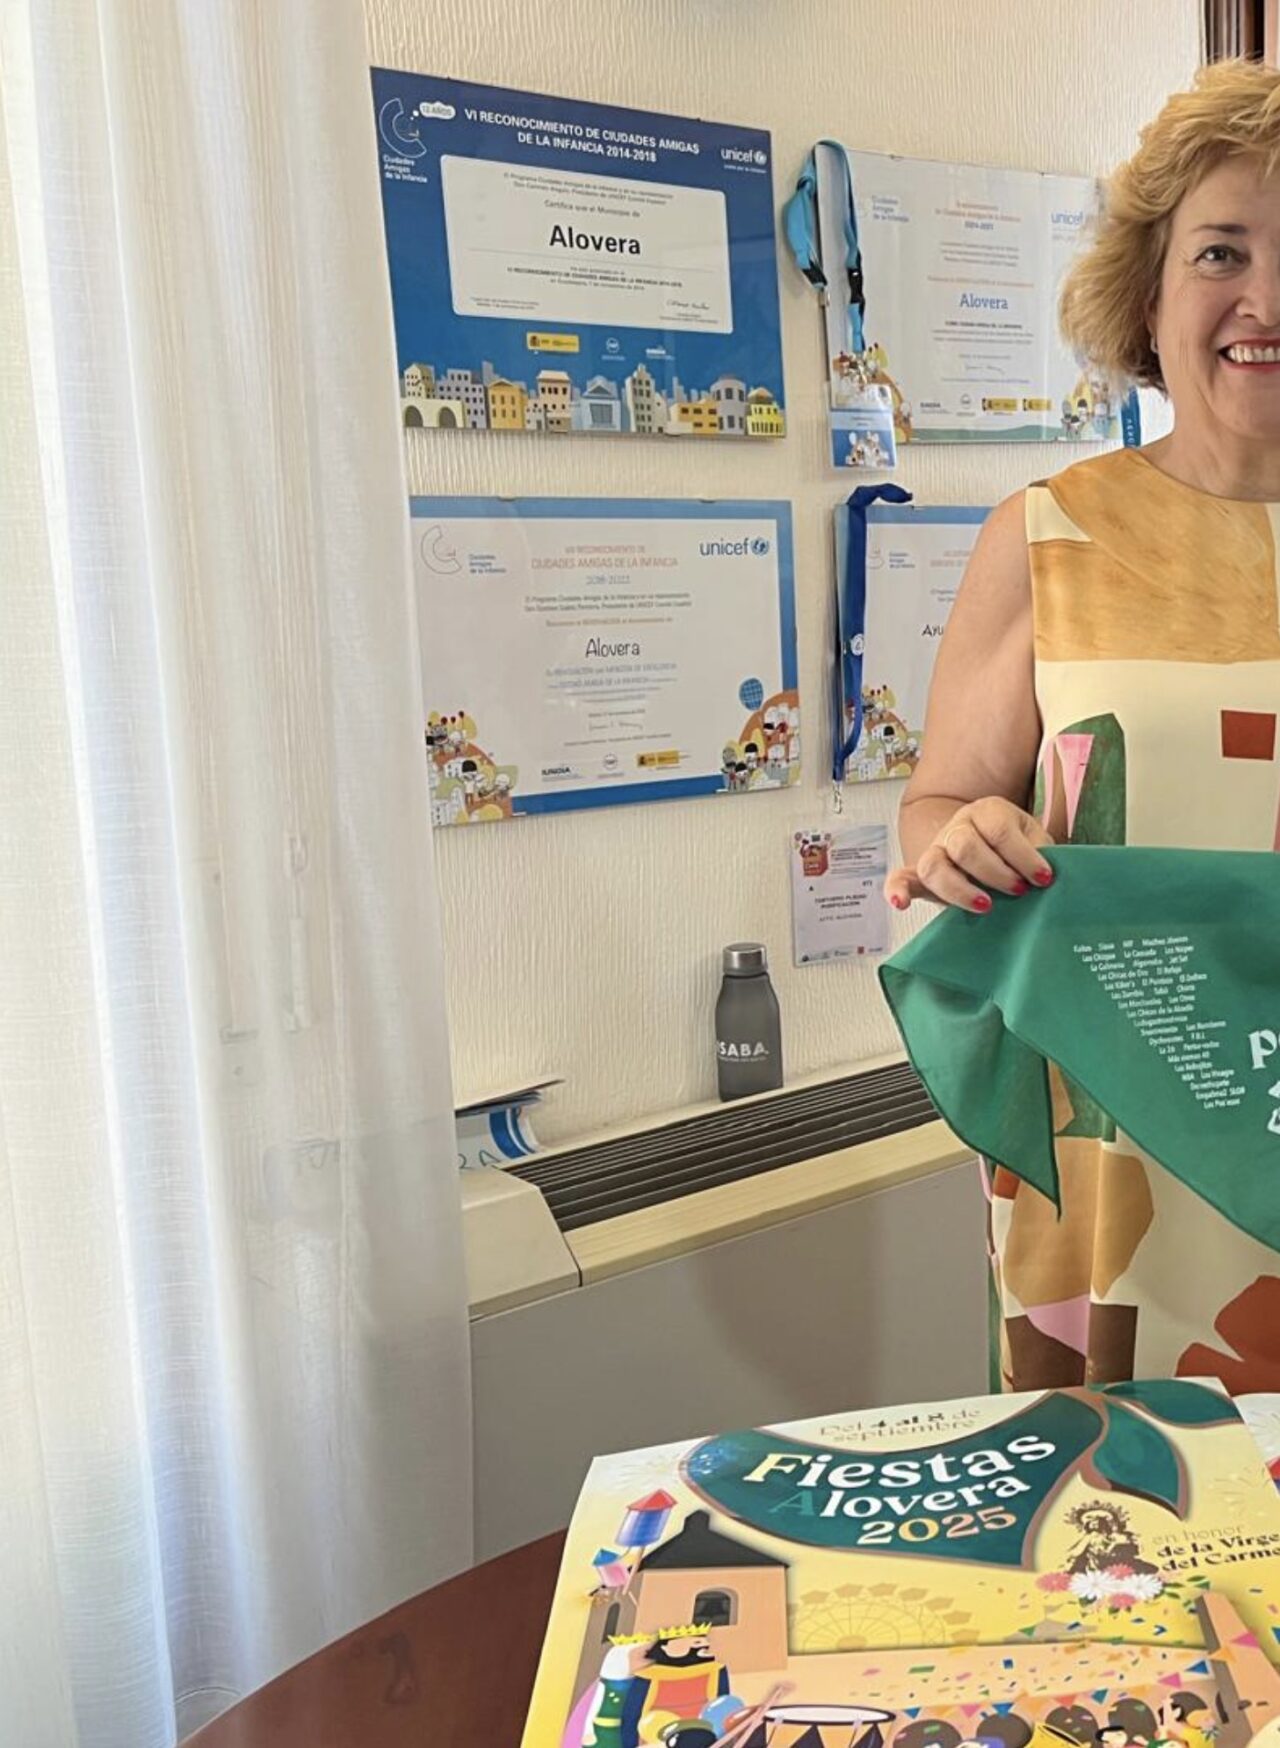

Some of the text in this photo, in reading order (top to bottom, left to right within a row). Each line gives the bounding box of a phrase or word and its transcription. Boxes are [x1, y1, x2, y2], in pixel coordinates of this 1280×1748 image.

[464, 109, 700, 155] VI RECONOCIMIENTO DE CIUDADES AMIGAS
[517, 132, 657, 163] DE LA INFANCIA 2014-2018
[720, 146, 753, 164] unicef
[549, 225, 641, 254] Alovera
[960, 293, 1009, 310] Alovera
[700, 537, 749, 557] unicef
[531, 556, 679, 570] CIUDADES AMIGAS DE LA INFANCIA
[585, 637, 641, 659] Alovera
[717, 1041, 769, 1057] SABA
[821, 1421, 862, 1436] Del
[952, 1409, 980, 1420] de
[834, 1420, 975, 1442] septiembre
[743, 1435, 1057, 1489] Fiestas
[768, 1473, 1031, 1518] Alovera
[856, 1506, 1017, 1546] 2025
[1152, 1524, 1246, 1546] en honor
[1156, 1543, 1188, 1558] de
[1191, 1540, 1213, 1554] la
[1161, 1557, 1200, 1573] del
